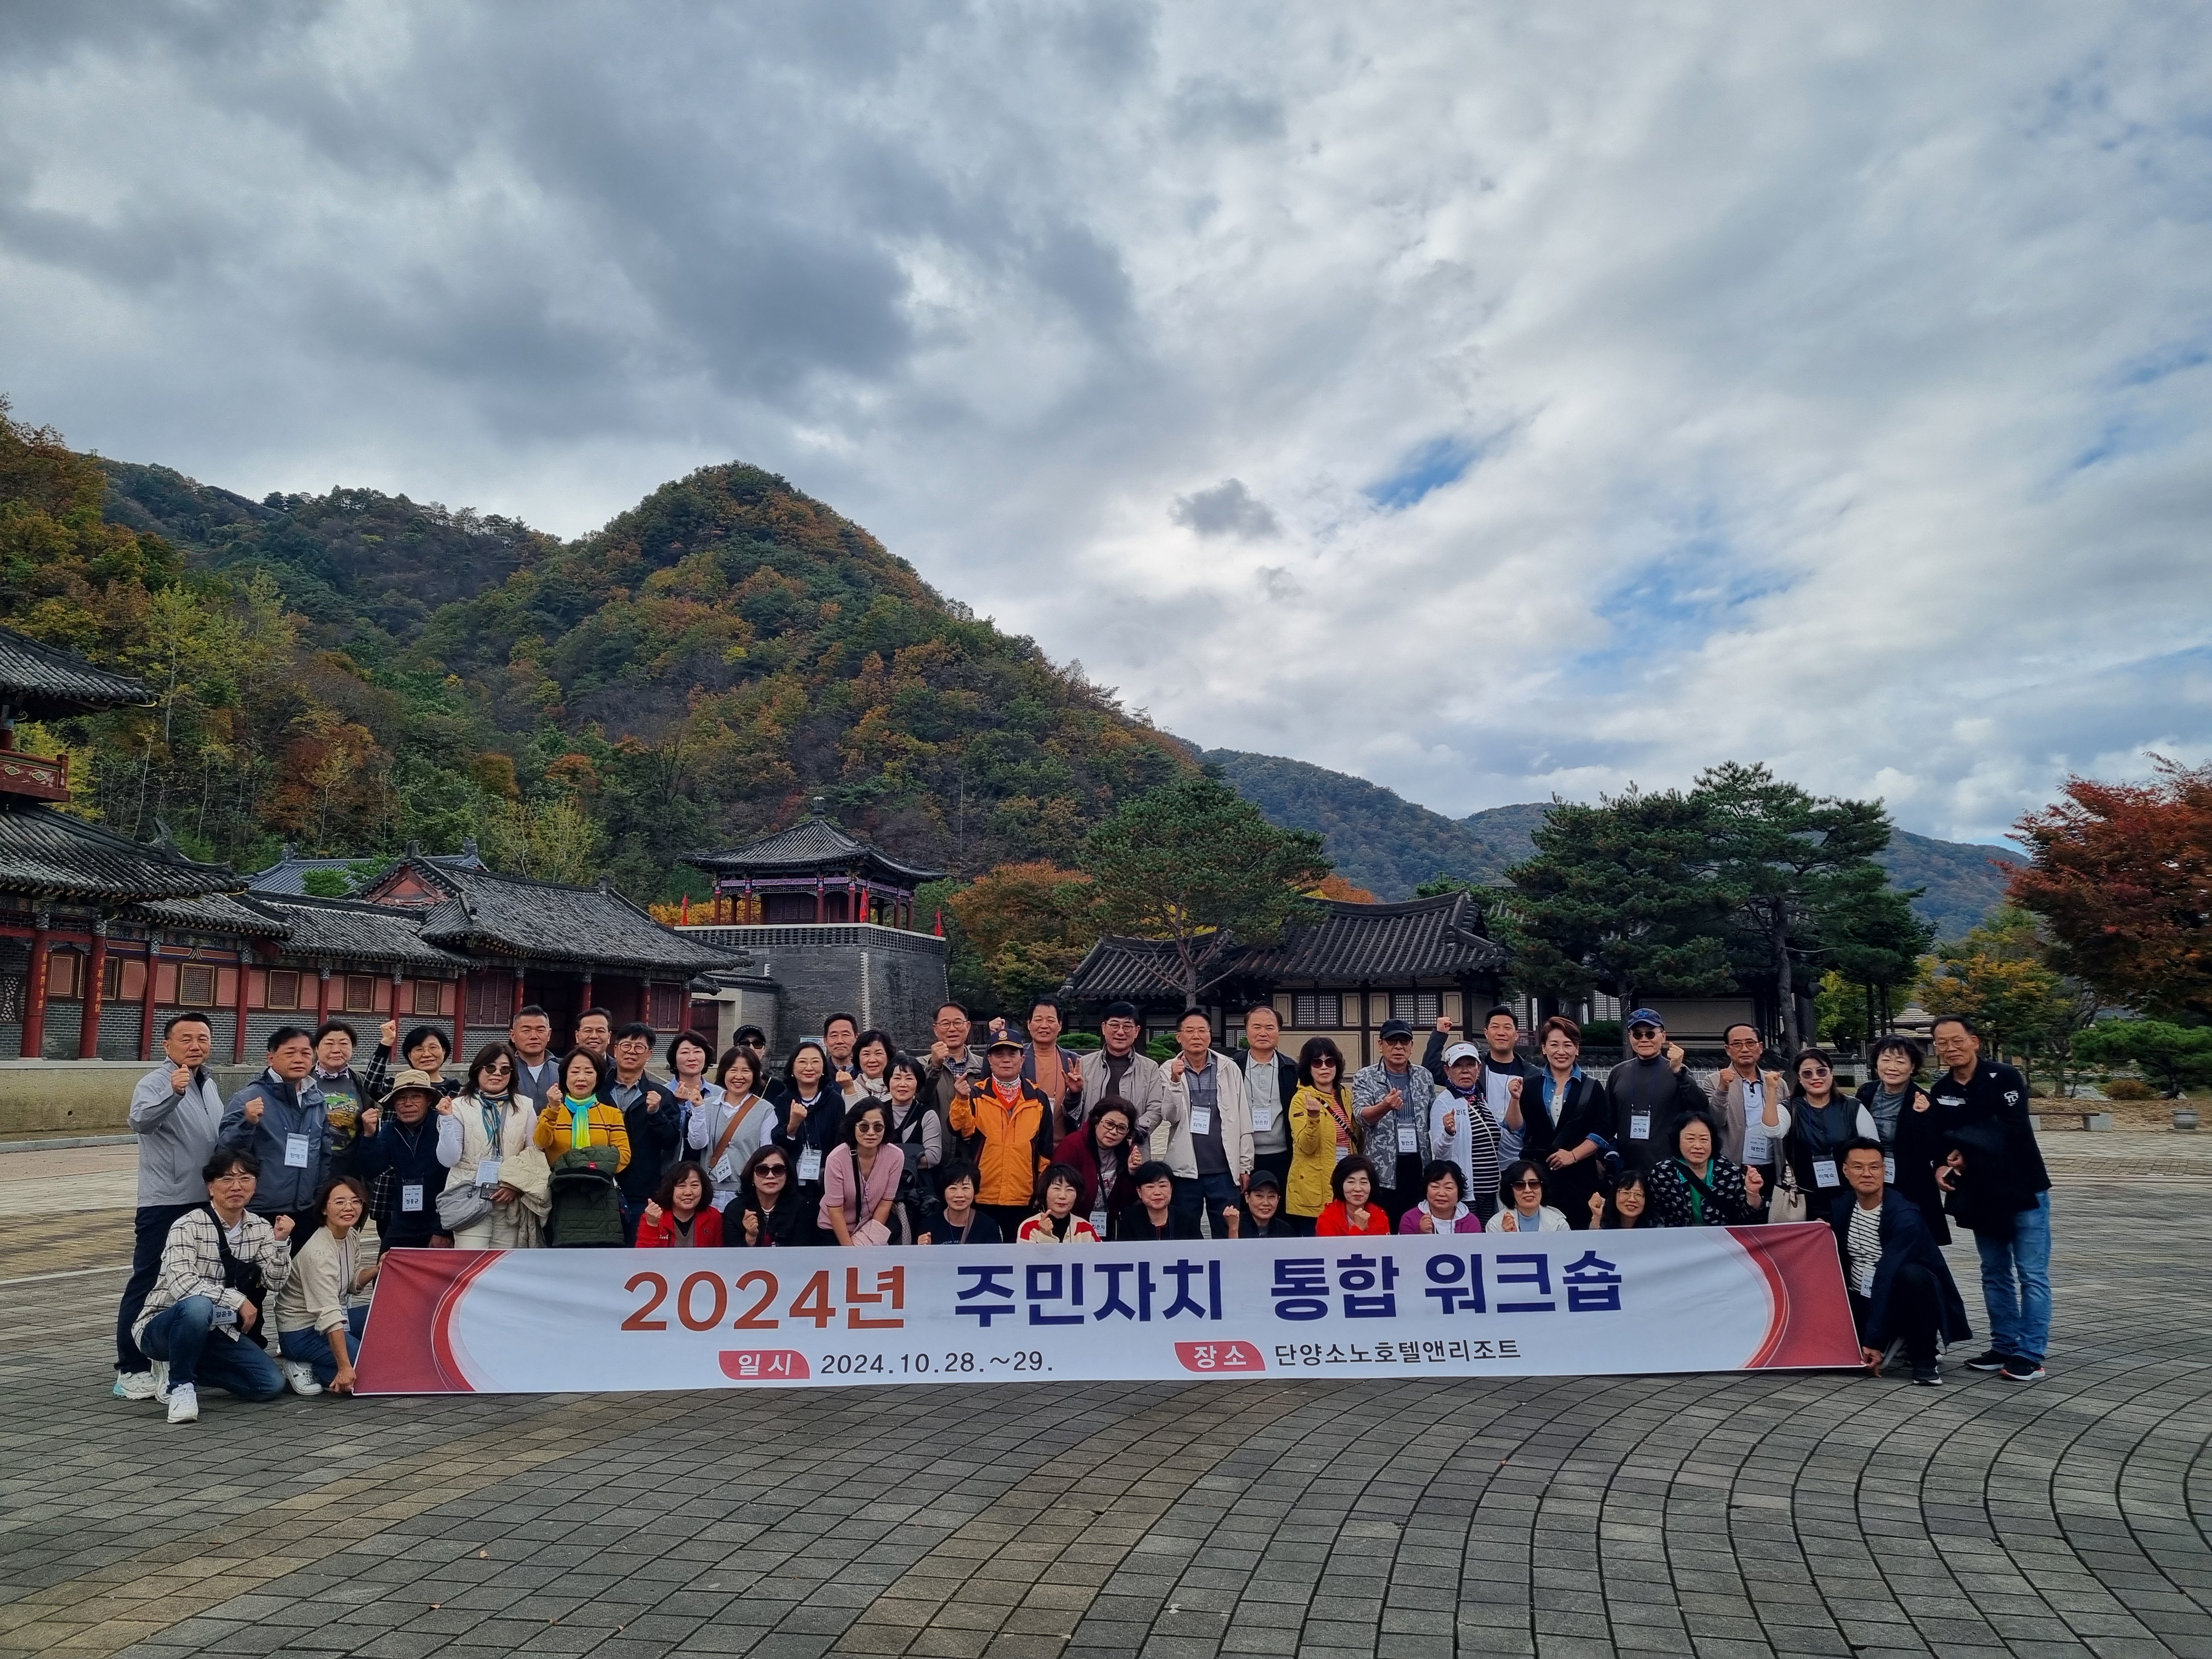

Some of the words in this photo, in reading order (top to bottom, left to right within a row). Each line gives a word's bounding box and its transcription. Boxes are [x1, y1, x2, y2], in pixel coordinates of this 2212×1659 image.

[621, 1265, 905, 1331] 2024년
[955, 1259, 1222, 1327] 주민자치
[1271, 1254, 1399, 1321] 통합
[1425, 1250, 1622, 1314] 워크숍
[821, 1351, 1052, 1373] 2024.10.28.~29.
[1275, 1340, 1521, 1366] 단양소노호텔앤리조트
